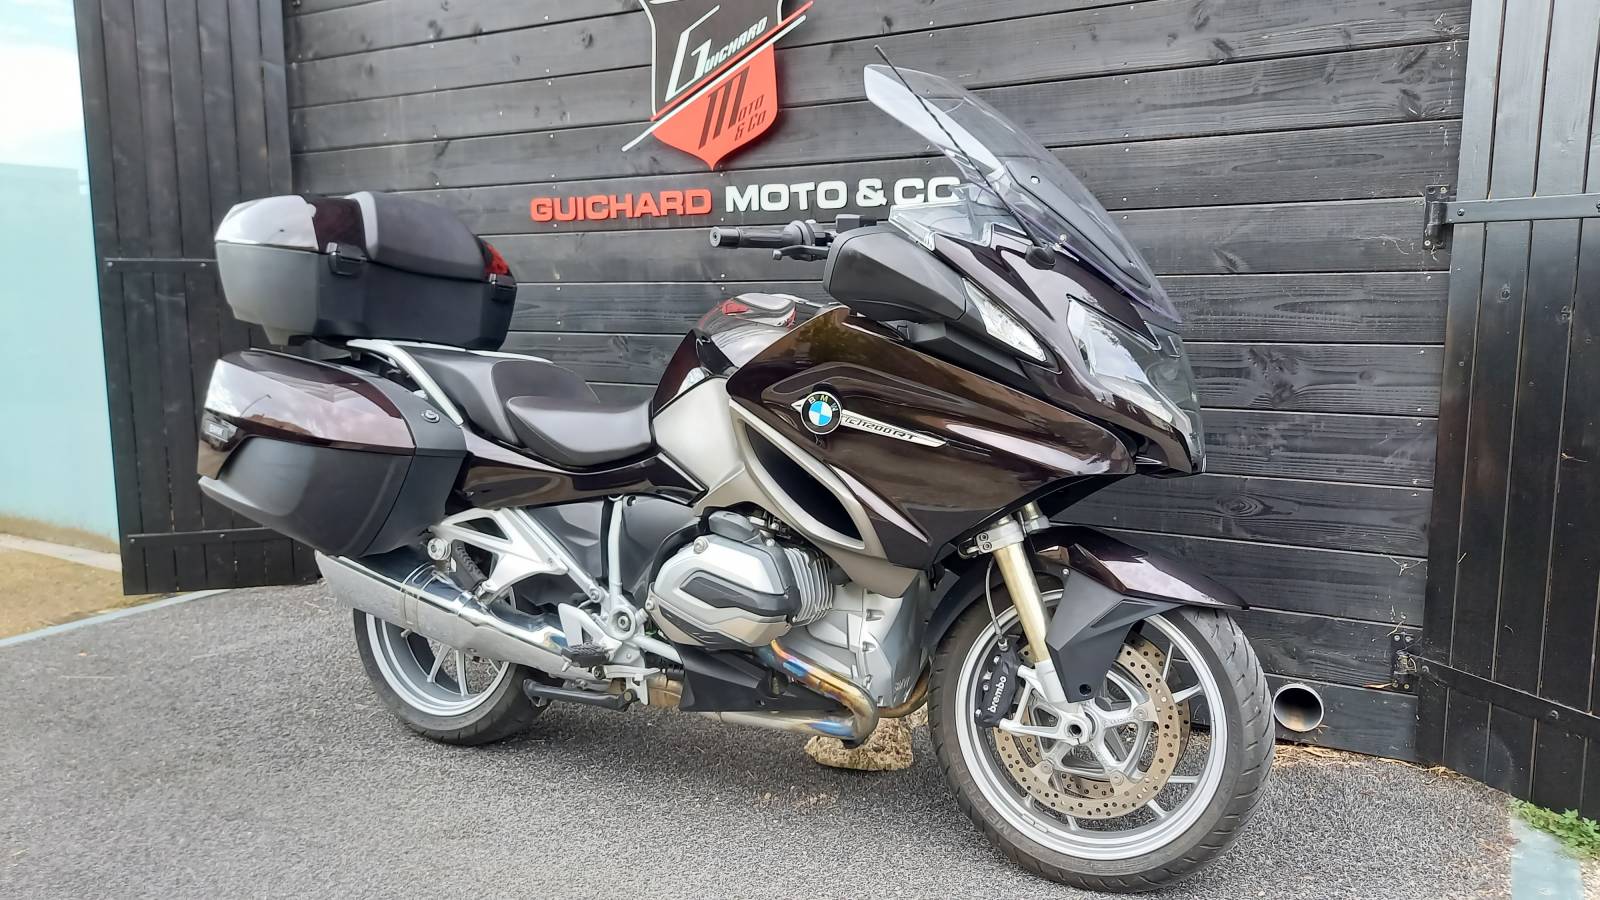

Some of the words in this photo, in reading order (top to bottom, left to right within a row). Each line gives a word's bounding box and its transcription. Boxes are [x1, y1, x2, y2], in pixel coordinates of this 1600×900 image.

[530, 188, 712, 222] GUICHARD
[725, 180, 848, 213] MOTO
[856, 178, 888, 207] &
[987, 675, 1007, 713] brembo
